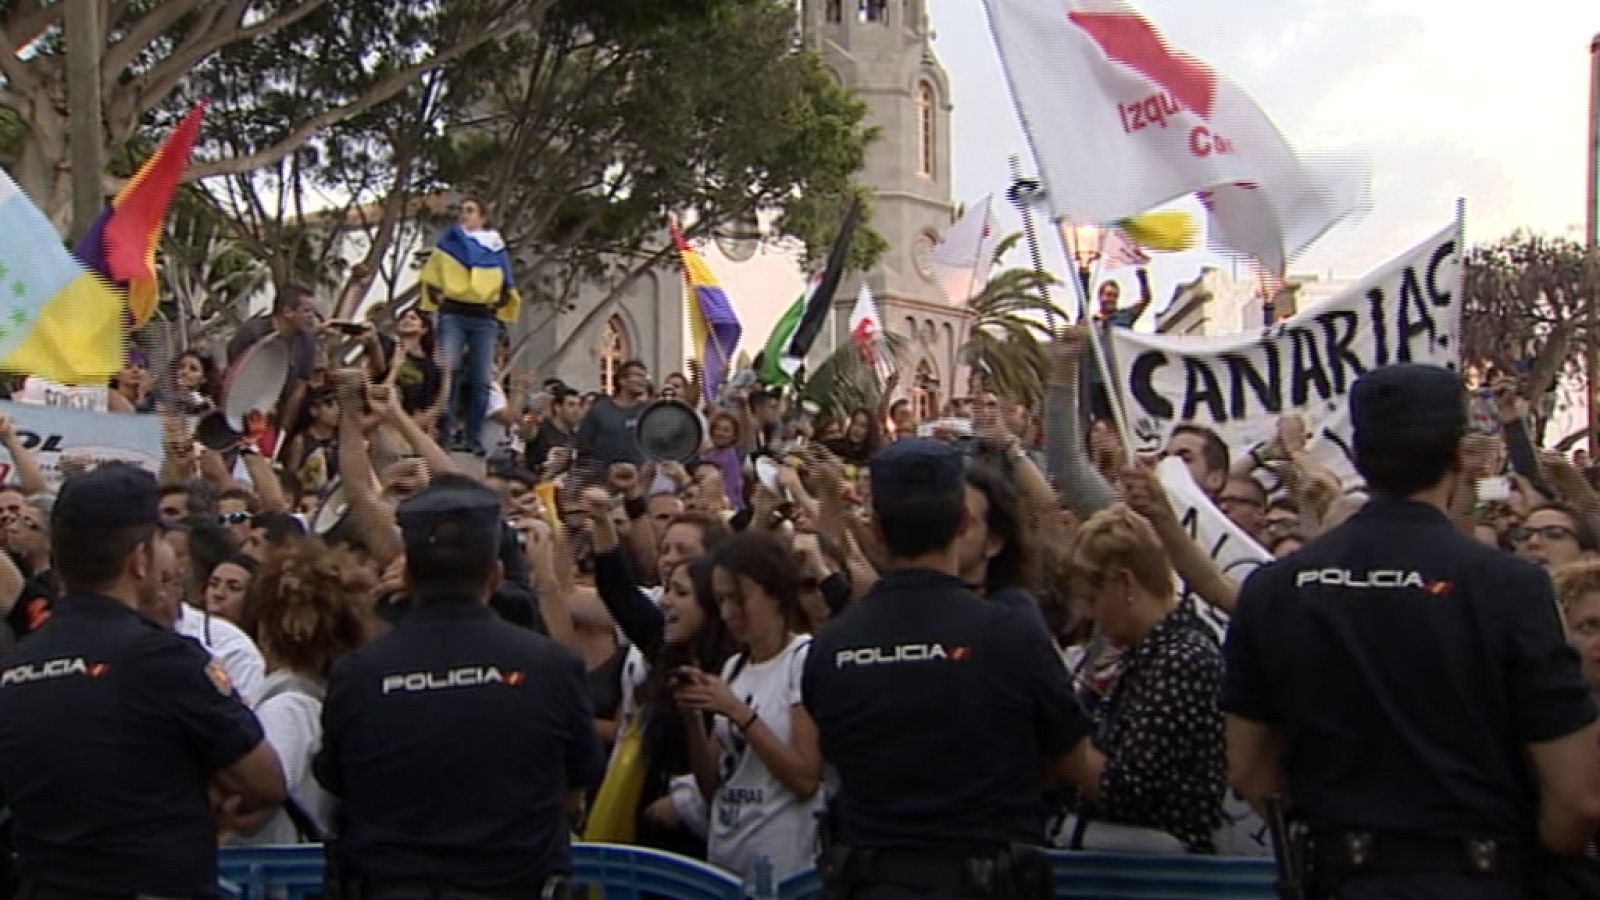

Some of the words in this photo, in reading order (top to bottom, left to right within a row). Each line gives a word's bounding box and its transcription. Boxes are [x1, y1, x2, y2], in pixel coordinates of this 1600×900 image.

[1117, 91, 1181, 134] Izqu
[1296, 568, 1425, 588] POLICIA
[836, 643, 948, 670] POLICIA
[0, 657, 87, 688] POLICIA
[382, 666, 503, 695] POLICIA
